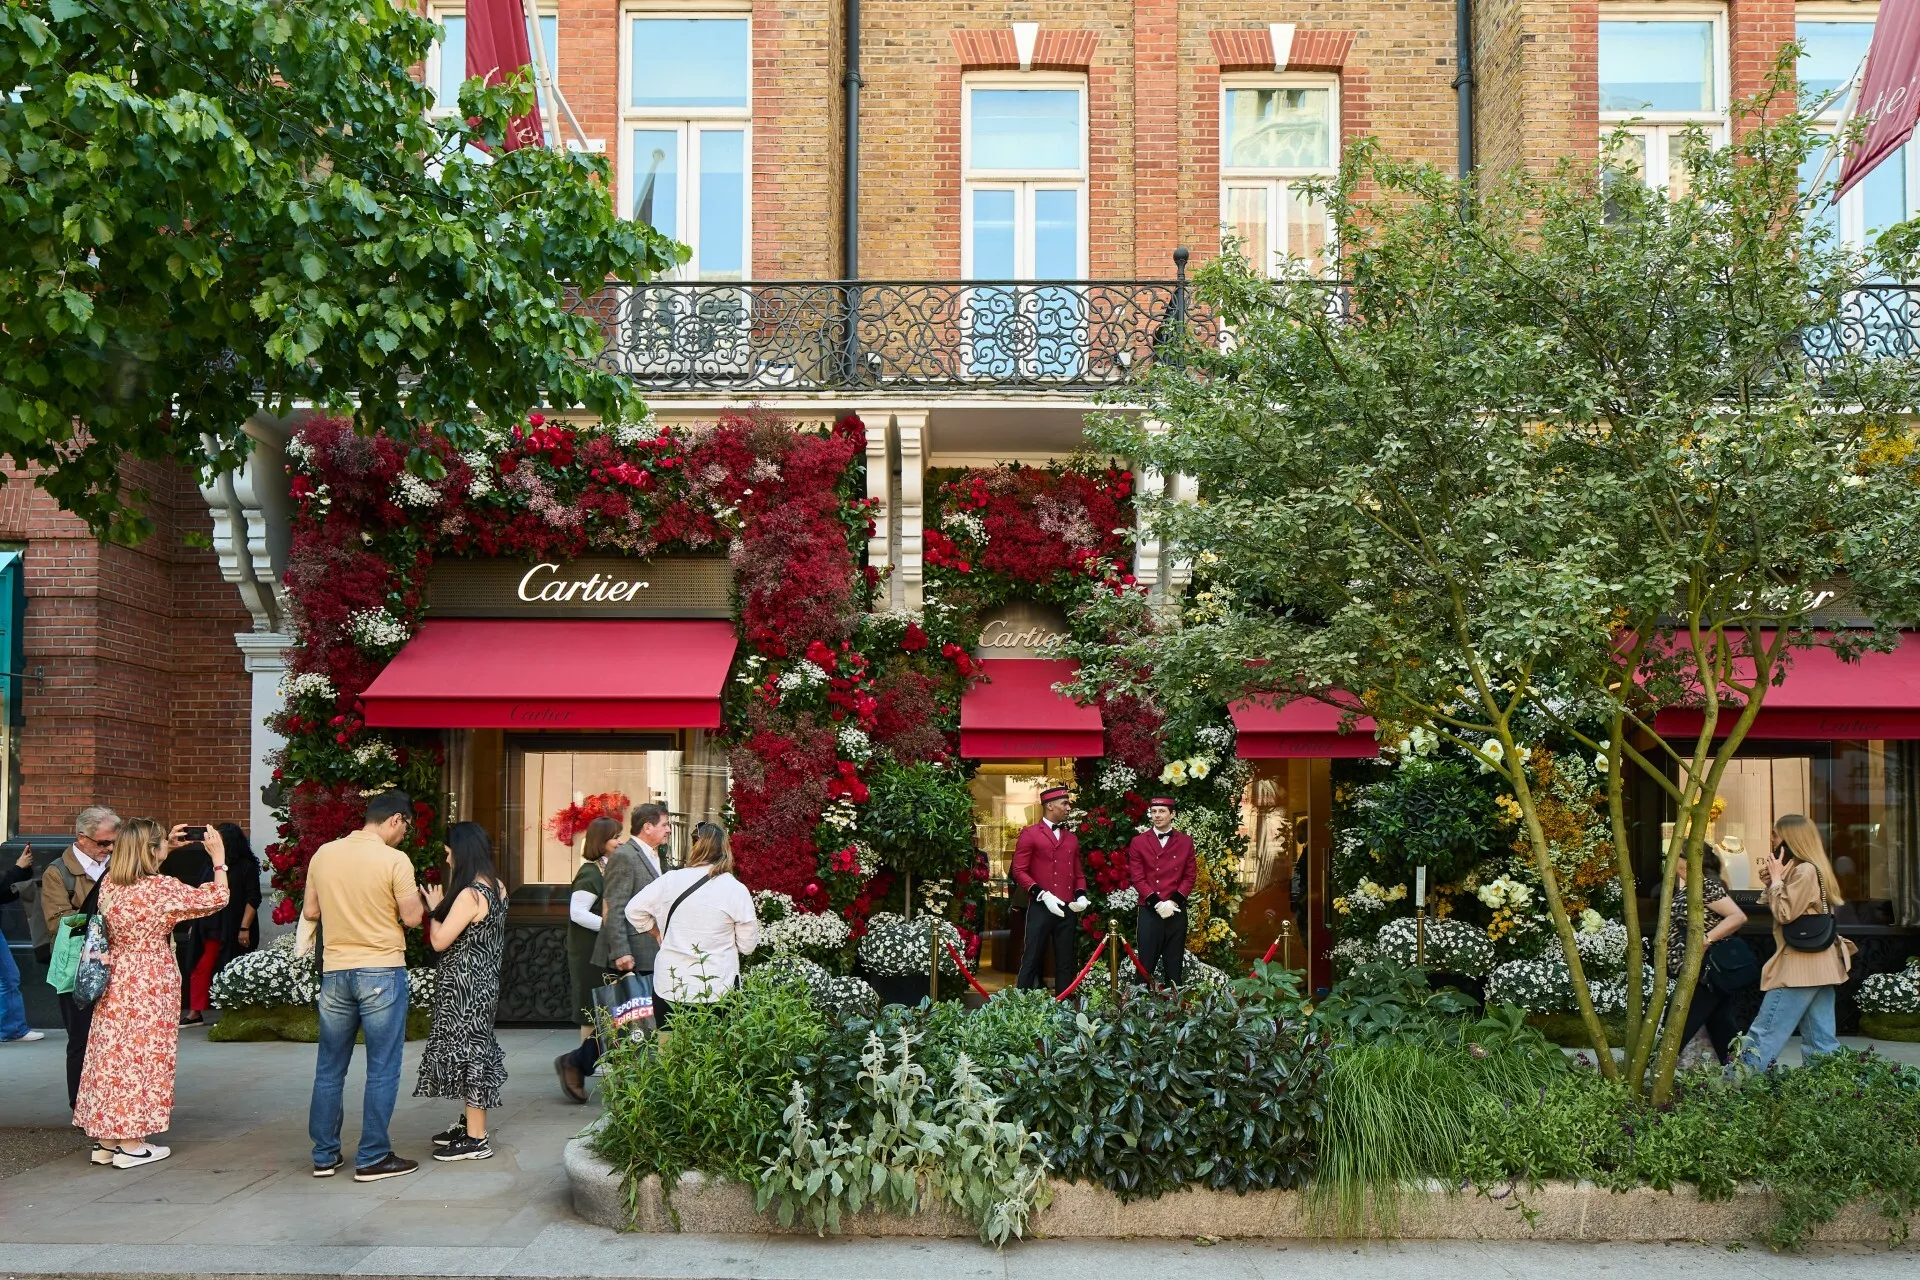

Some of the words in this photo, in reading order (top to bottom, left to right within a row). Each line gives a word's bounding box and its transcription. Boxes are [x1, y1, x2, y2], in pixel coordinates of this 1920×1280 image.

[518, 563, 649, 601] Cartier
[978, 620, 1072, 648] Cartier
[510, 703, 575, 721] Cartier
[616, 997, 652, 1016] SPORTS
